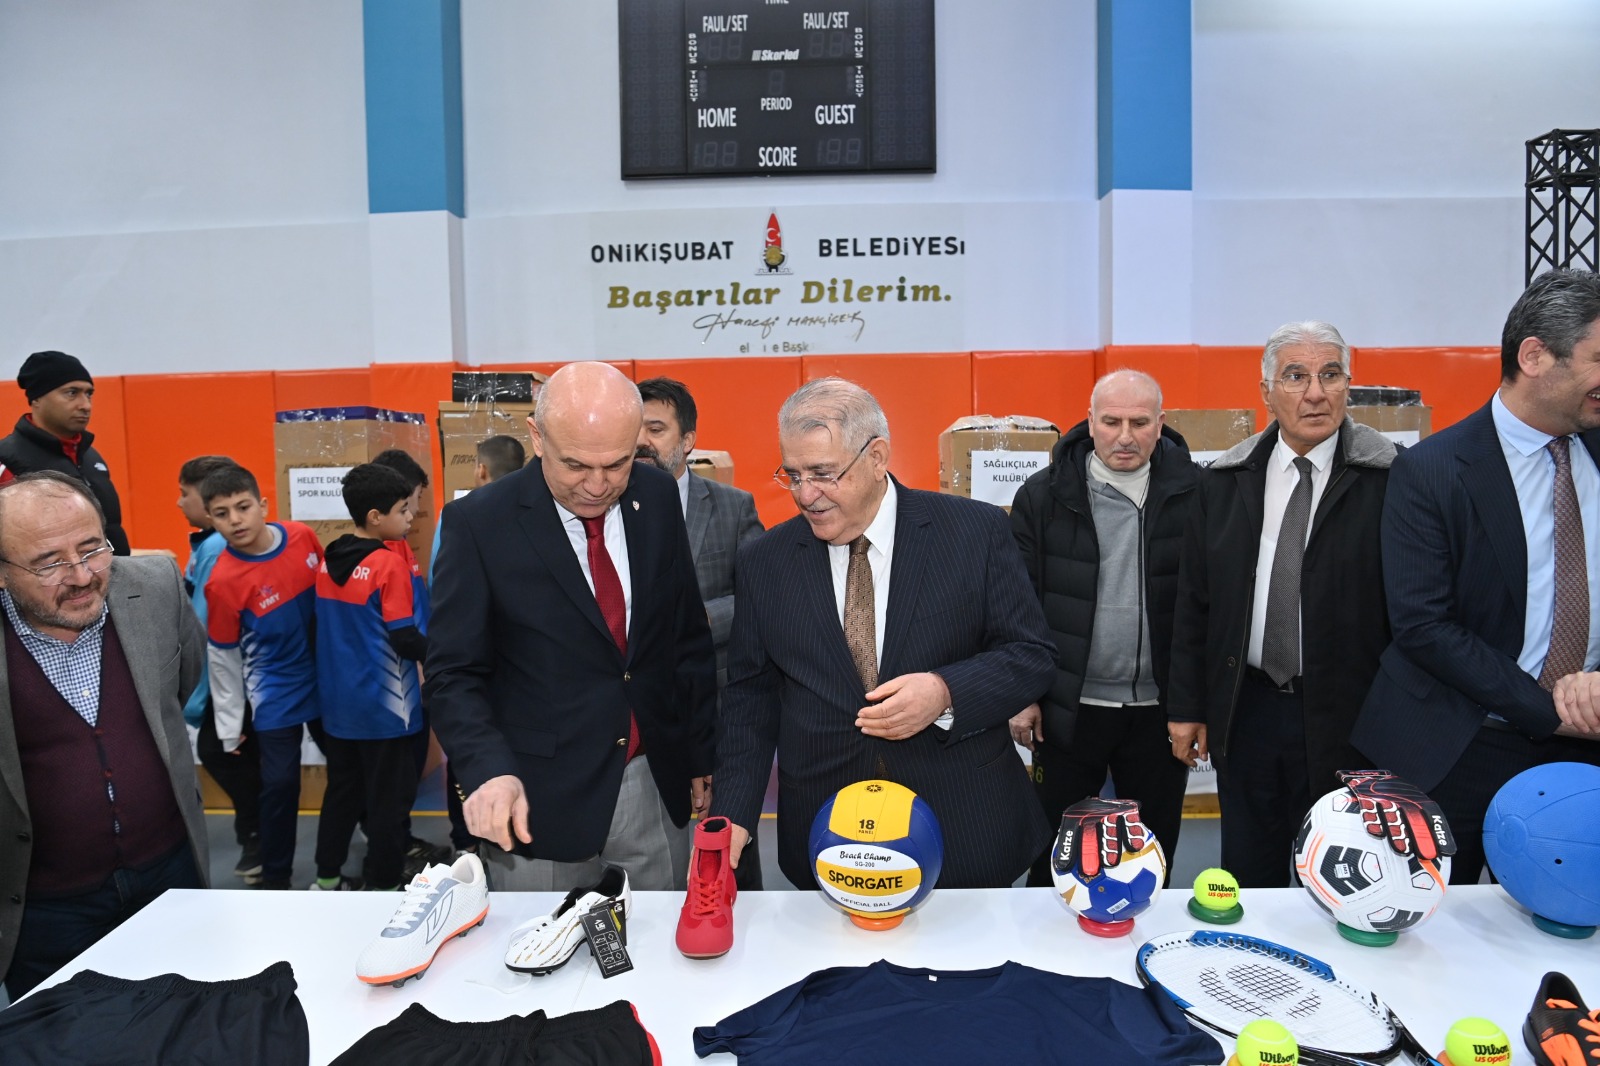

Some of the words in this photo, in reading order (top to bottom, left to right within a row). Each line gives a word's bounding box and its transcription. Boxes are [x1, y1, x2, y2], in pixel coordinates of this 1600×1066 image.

[702, 14, 748, 32] FAUL/SET
[803, 12, 849, 29] FAUL/SET
[761, 97, 792, 111] PERIOD
[698, 107, 737, 128] HOME
[815, 104, 856, 125] GUEST
[758, 146, 797, 167] SCORE
[607, 282, 780, 314] Başarılar
[801, 277, 952, 303] Dilerim.
[983, 459, 1038, 469] SAĞLIKÇILAR
[297, 476, 325, 484] HELETE
[992, 473, 1028, 482] KULÜBÜ
[298, 489, 319, 497] SPOR
[859, 819, 875, 830] 18
[1431, 814, 1447, 846] Katze
[1060, 830, 1074, 861] Katze
[839, 850, 862, 859] Beach
[863, 852, 892, 863] Champ
[828, 870, 903, 890] SPORGATE
[1208, 883, 1236, 892] Wilson
[840, 896, 872, 908] OFFICIAL
[1472, 1044, 1509, 1055] Wilson
[1259, 1051, 1295, 1063] Wilson
